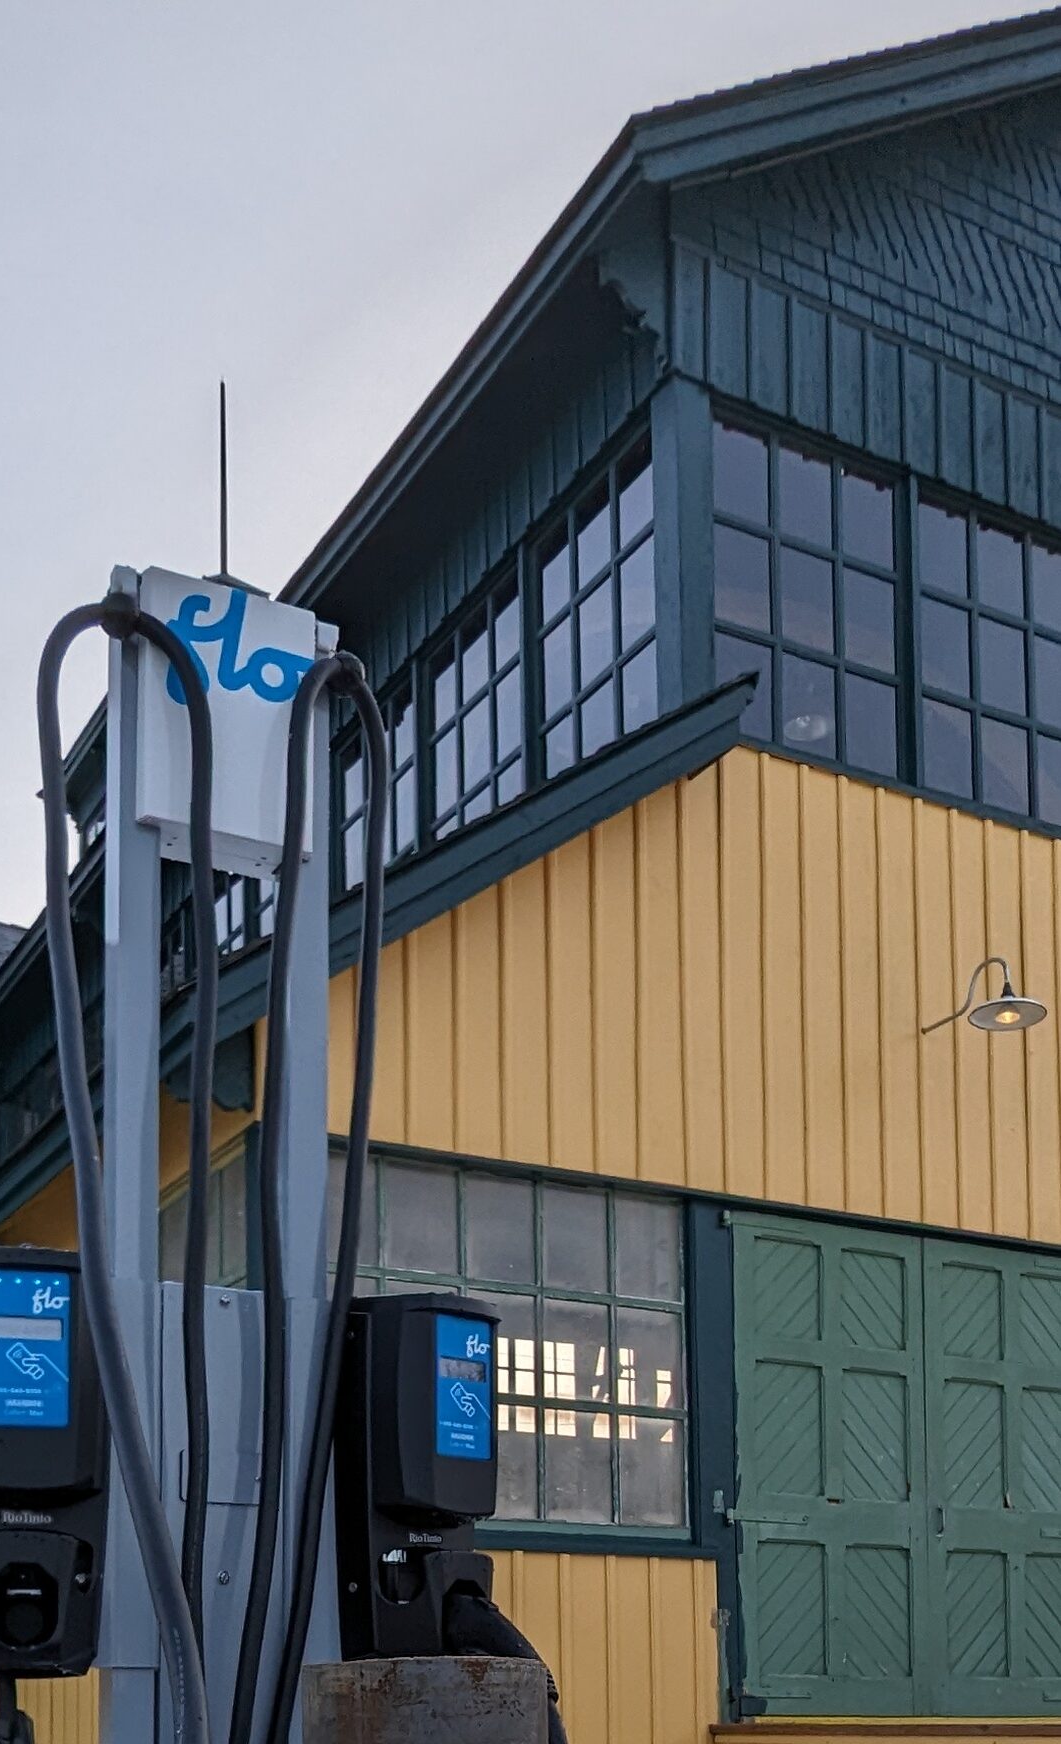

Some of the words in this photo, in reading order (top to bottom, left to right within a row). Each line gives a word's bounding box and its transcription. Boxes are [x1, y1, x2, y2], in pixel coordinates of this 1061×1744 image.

[166, 589, 315, 705] flo
[32, 1286, 70, 1314] flo
[466, 1334, 491, 1357] flo
